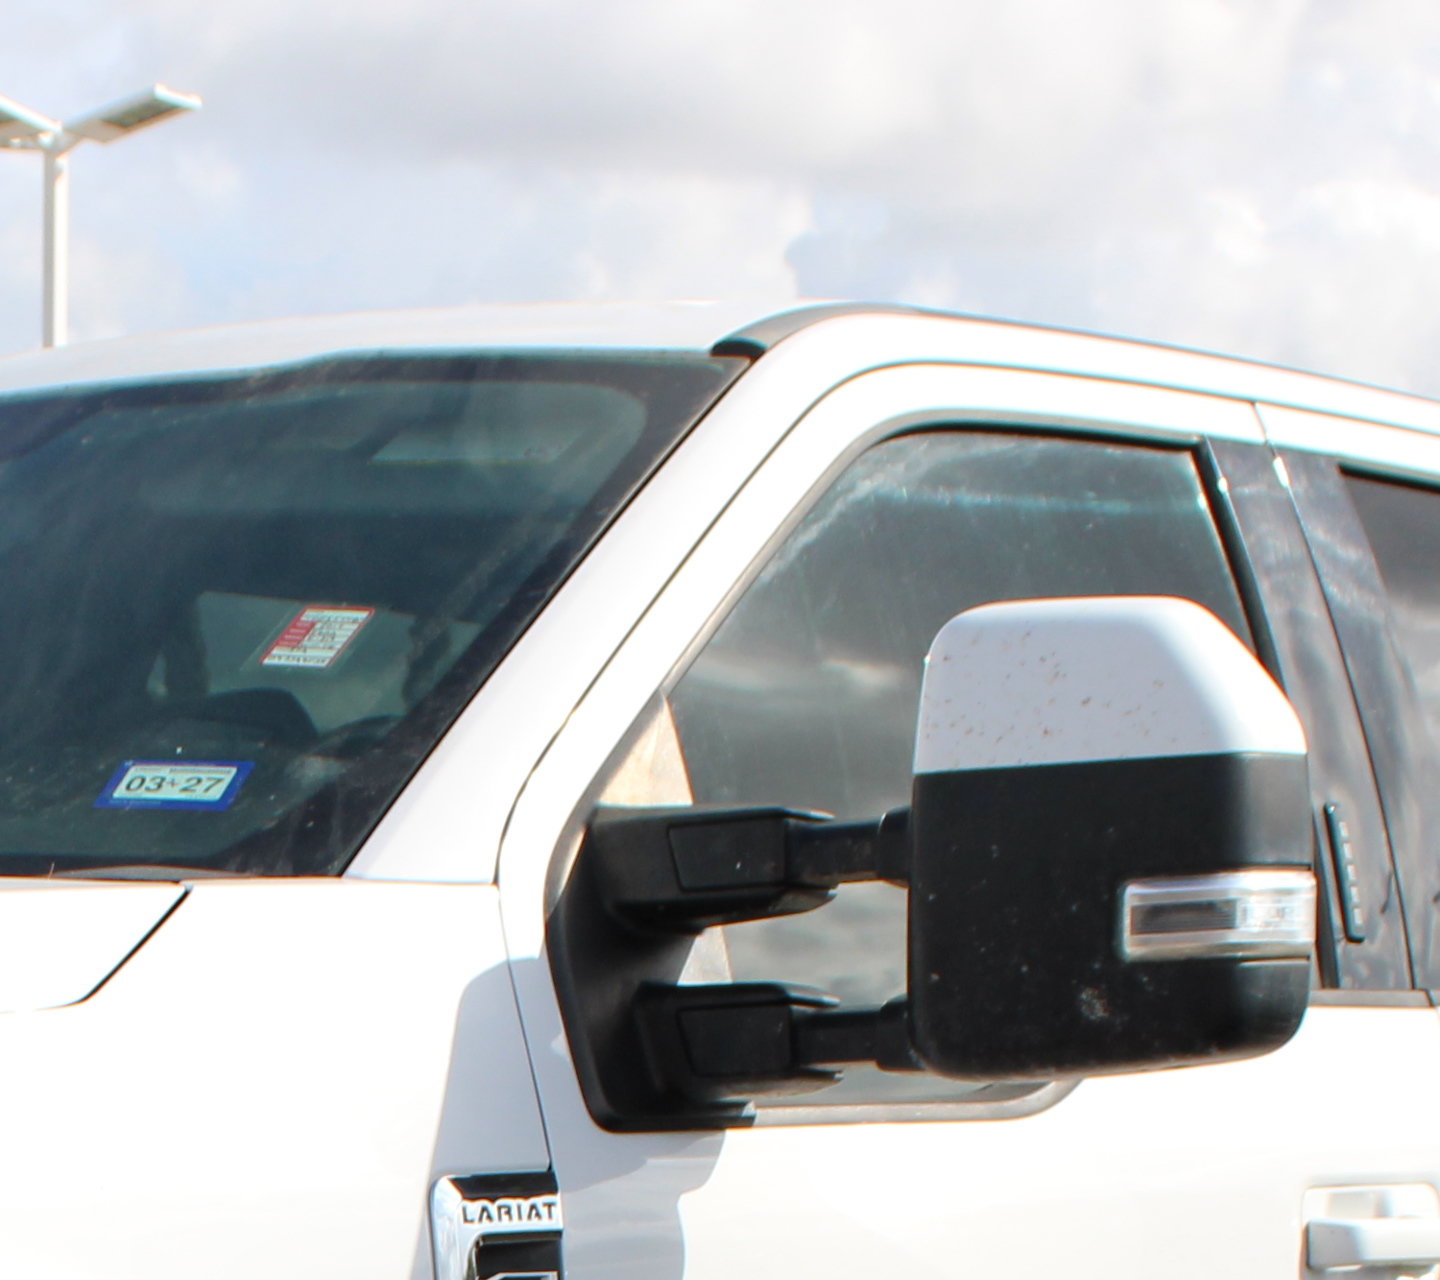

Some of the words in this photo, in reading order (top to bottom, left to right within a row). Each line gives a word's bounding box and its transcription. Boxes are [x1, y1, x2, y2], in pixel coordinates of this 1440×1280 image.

[125, 775, 164, 793] 03
[179, 776, 224, 794] 27
[462, 1200, 559, 1224] LARIAT
